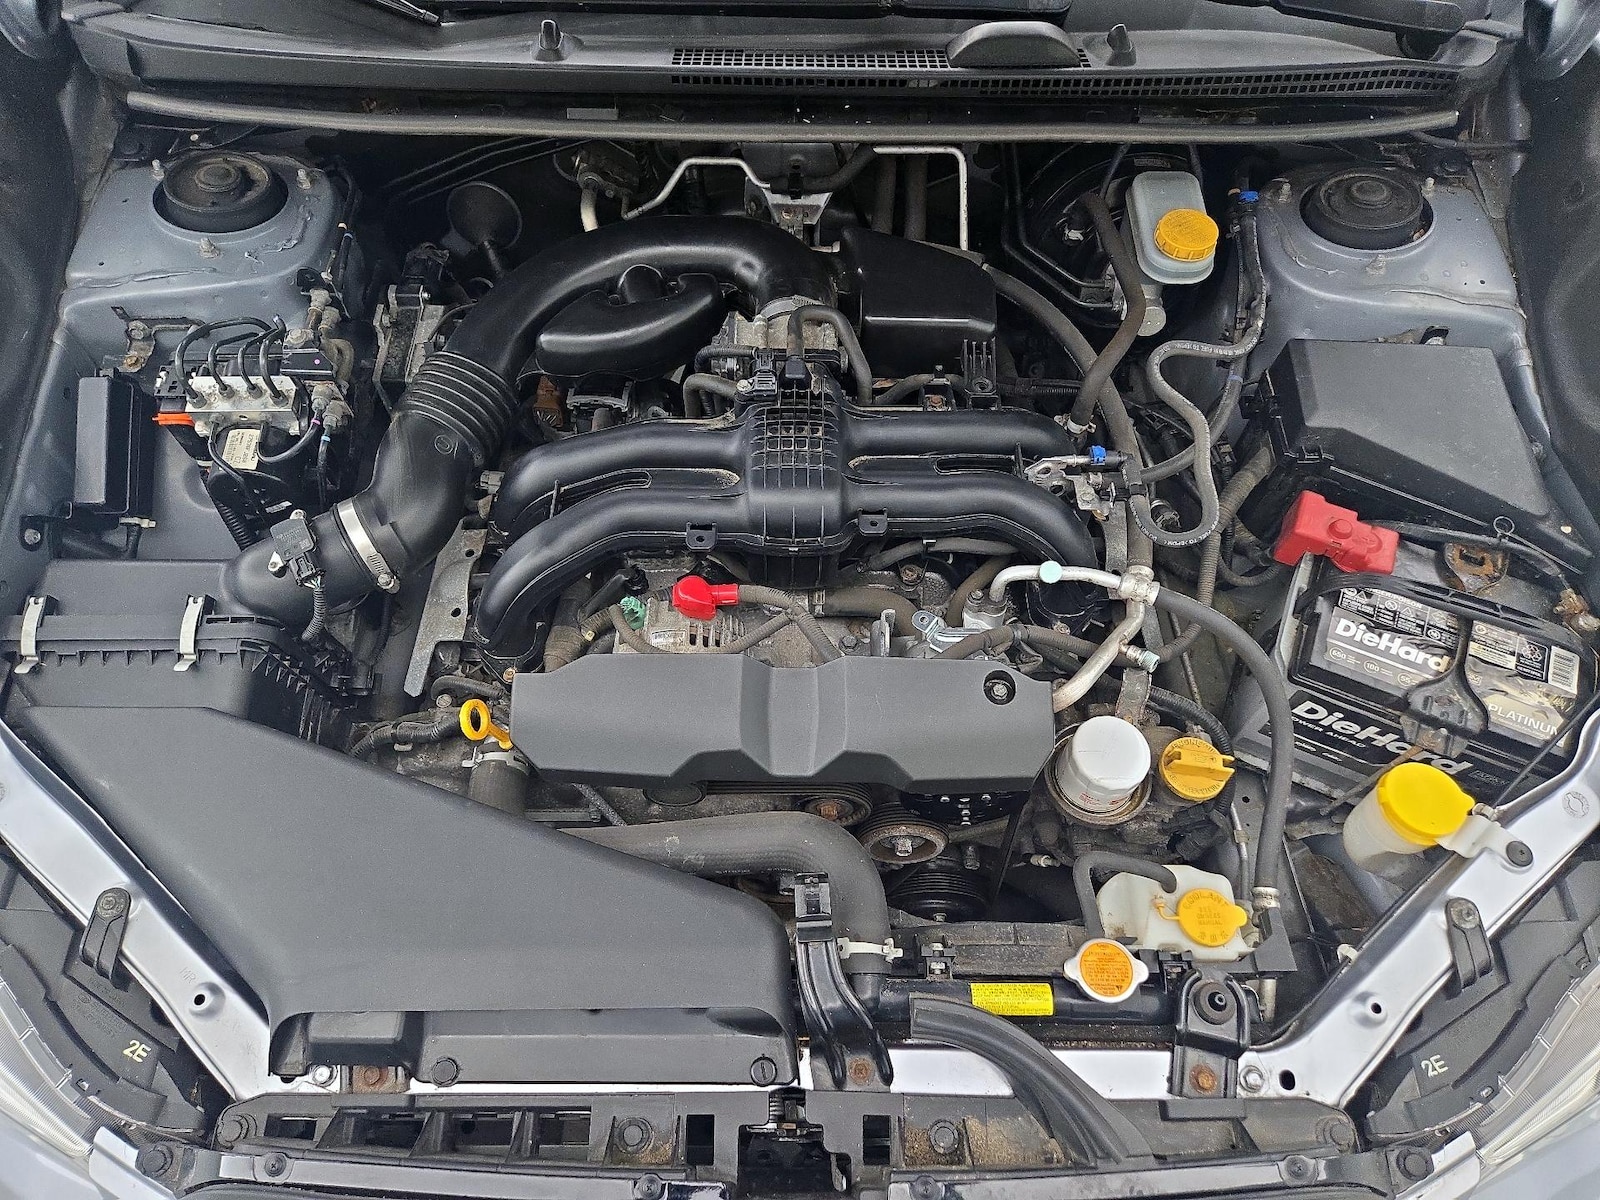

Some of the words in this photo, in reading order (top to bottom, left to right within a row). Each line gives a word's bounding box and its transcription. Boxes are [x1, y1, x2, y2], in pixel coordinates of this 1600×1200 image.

[1331, 650, 1347, 661] 650
[1335, 618, 1452, 673] DieHard
[1366, 662, 1380, 673] 100
[1291, 715, 1324, 733] OWER
[1326, 731, 1367, 749] AHEAD
[1292, 700, 1474, 775] DieHard
[123, 1040, 152, 1063] 2E
[1420, 1054, 1449, 1078] 2E
